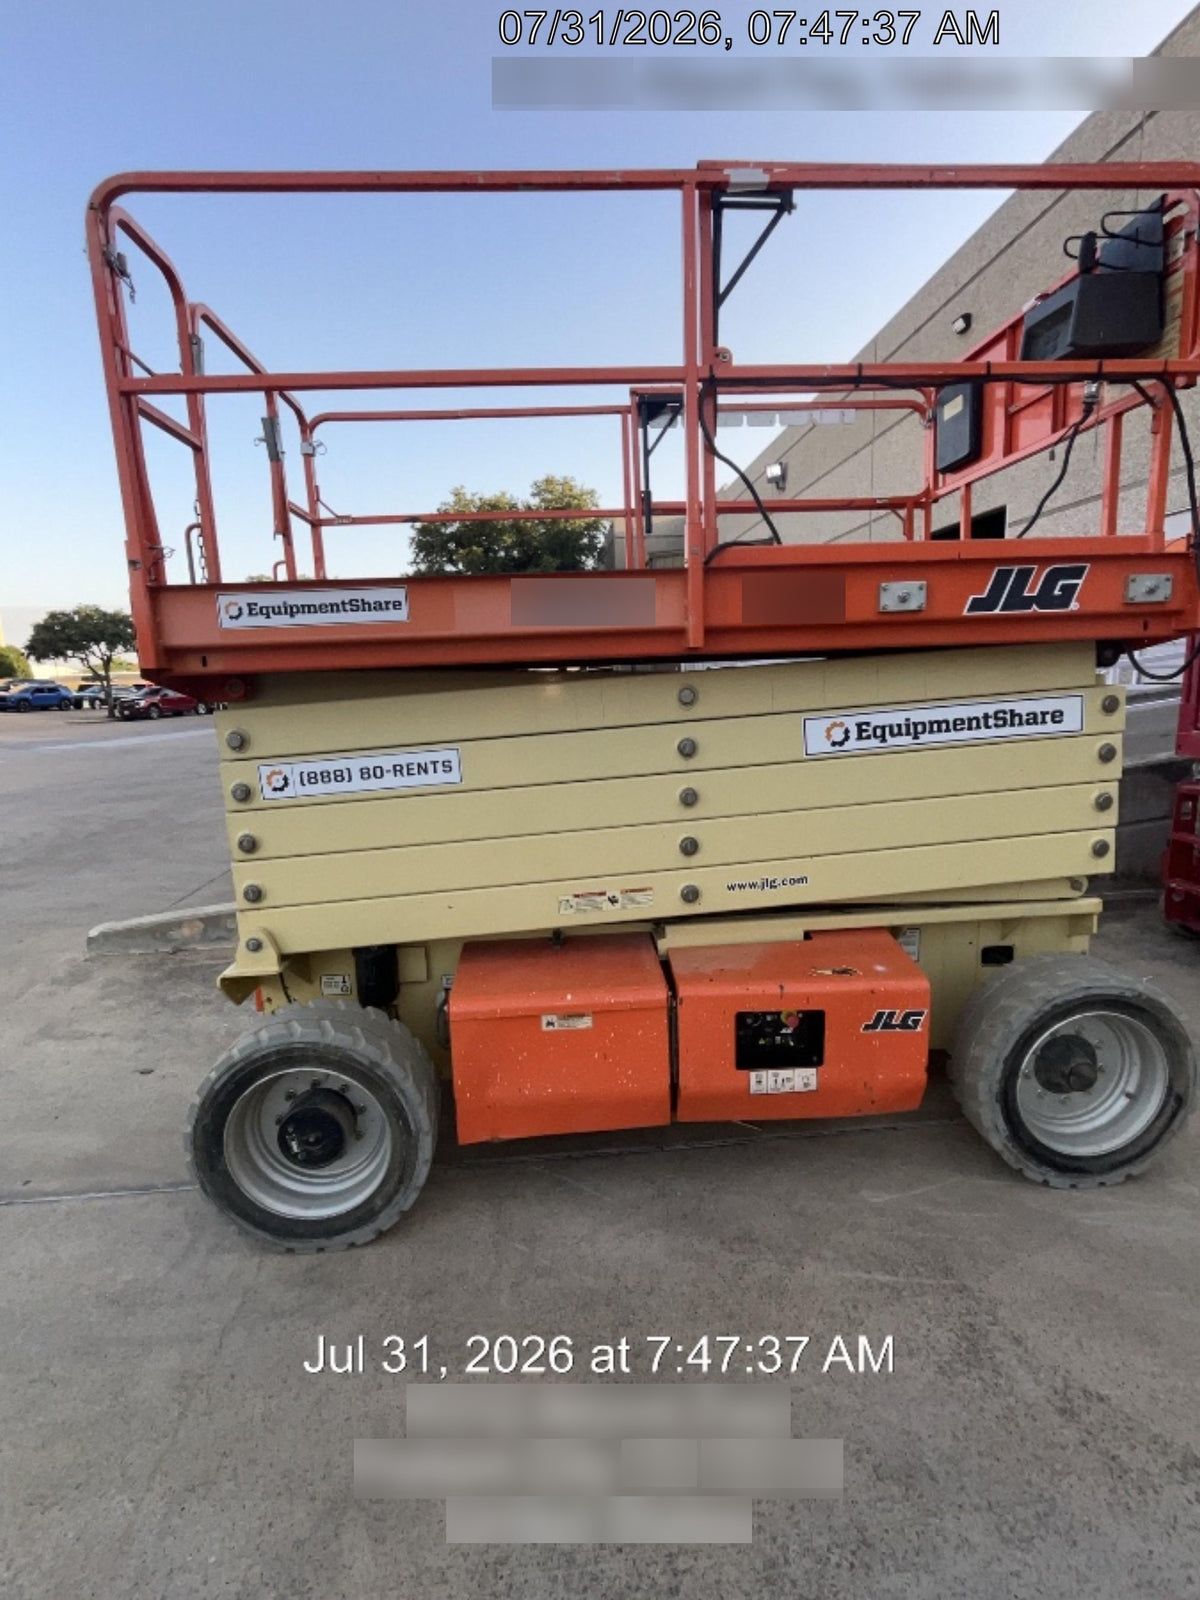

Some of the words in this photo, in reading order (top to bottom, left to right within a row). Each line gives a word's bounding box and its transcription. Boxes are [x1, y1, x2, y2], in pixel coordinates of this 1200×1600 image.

[963, 563, 1090, 615] JLG
[247, 597, 403, 620] EquipmentShare
[855, 708, 1064, 742] EquipmentShare
[299, 768, 353, 786] (888)
[359, 760, 453, 781] 80-RENTS
[726, 874, 808, 893] www.jlg.com
[861, 1010, 927, 1032] JLG
